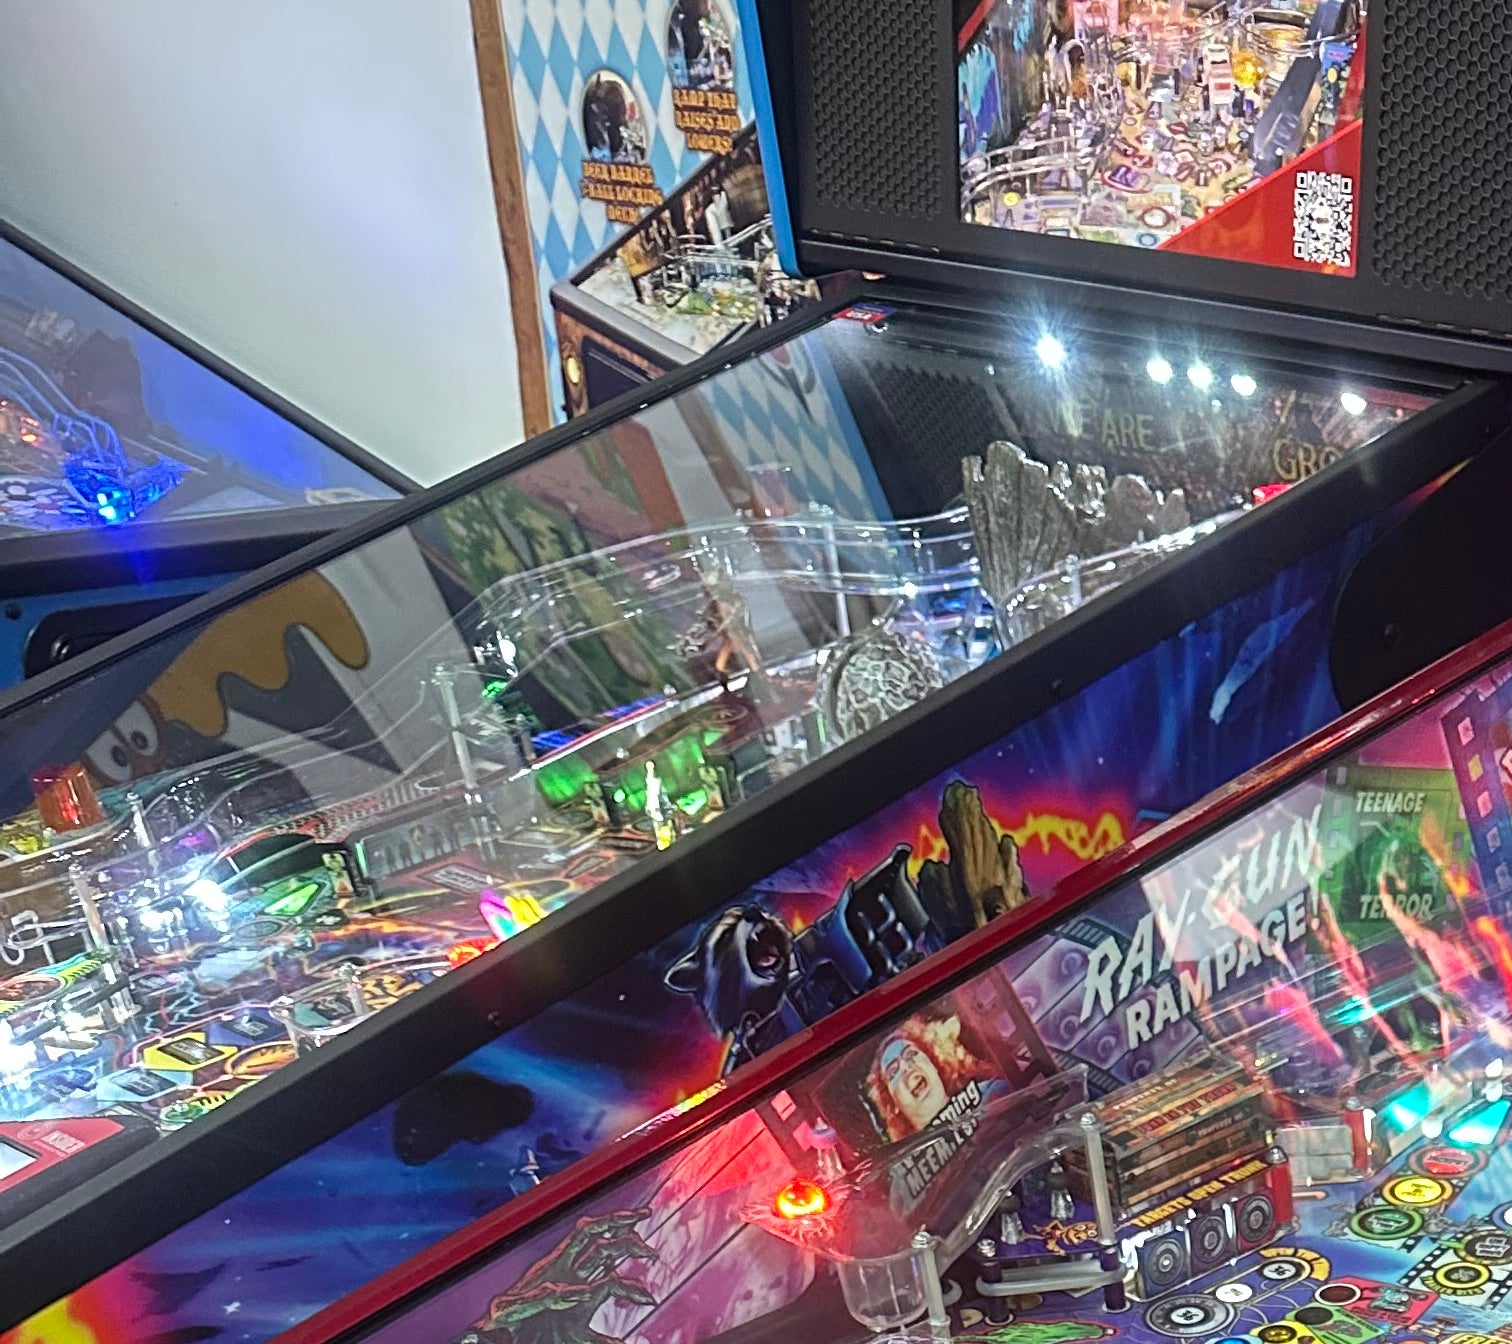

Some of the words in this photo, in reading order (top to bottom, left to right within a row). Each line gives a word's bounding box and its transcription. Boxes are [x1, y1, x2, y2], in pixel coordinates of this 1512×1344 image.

[1101, 410, 1157, 452] ARE
[1355, 790, 1427, 814] TEENAGE
[1080, 805, 1323, 1024] RAY-GUN
[1124, 890, 1322, 1049] RAMPAGE!
[1130, 1197, 1187, 1229] TARGETS
[1188, 1179, 1223, 1207] OPEN
